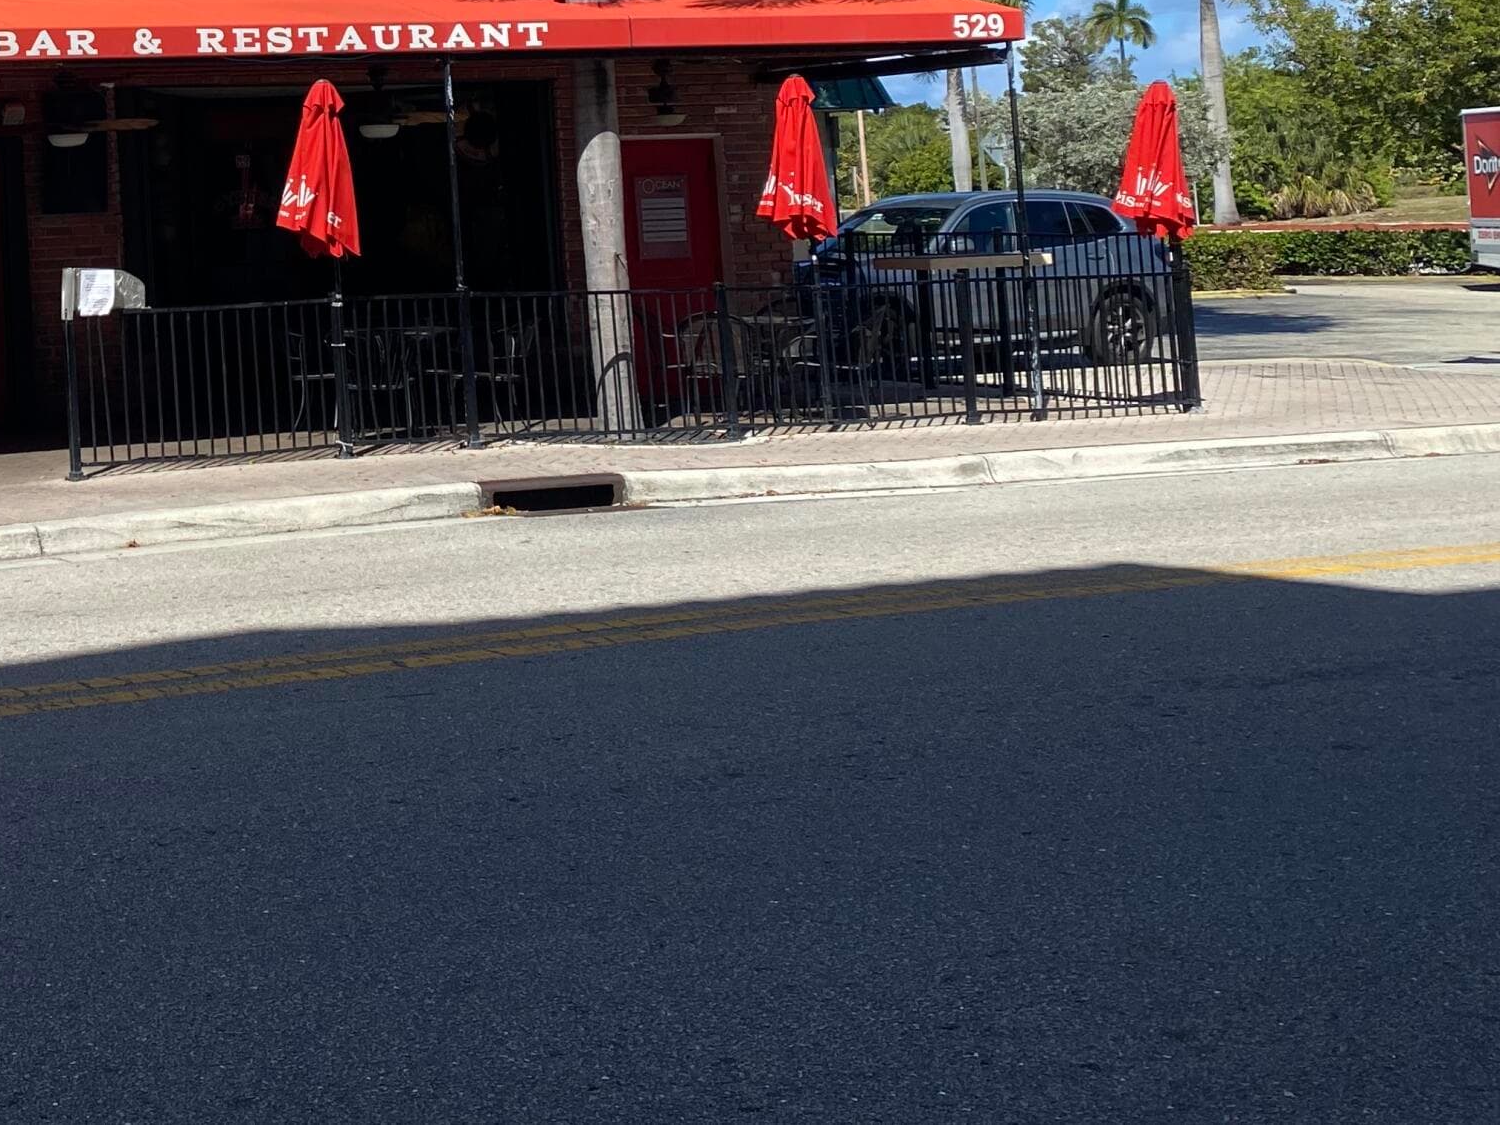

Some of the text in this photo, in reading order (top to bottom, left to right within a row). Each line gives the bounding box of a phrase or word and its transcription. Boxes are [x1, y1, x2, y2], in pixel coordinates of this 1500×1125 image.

[133, 28, 164, 56] &
[197, 22, 550, 54] RESTAURANT
[953, 13, 1004, 38] 529
